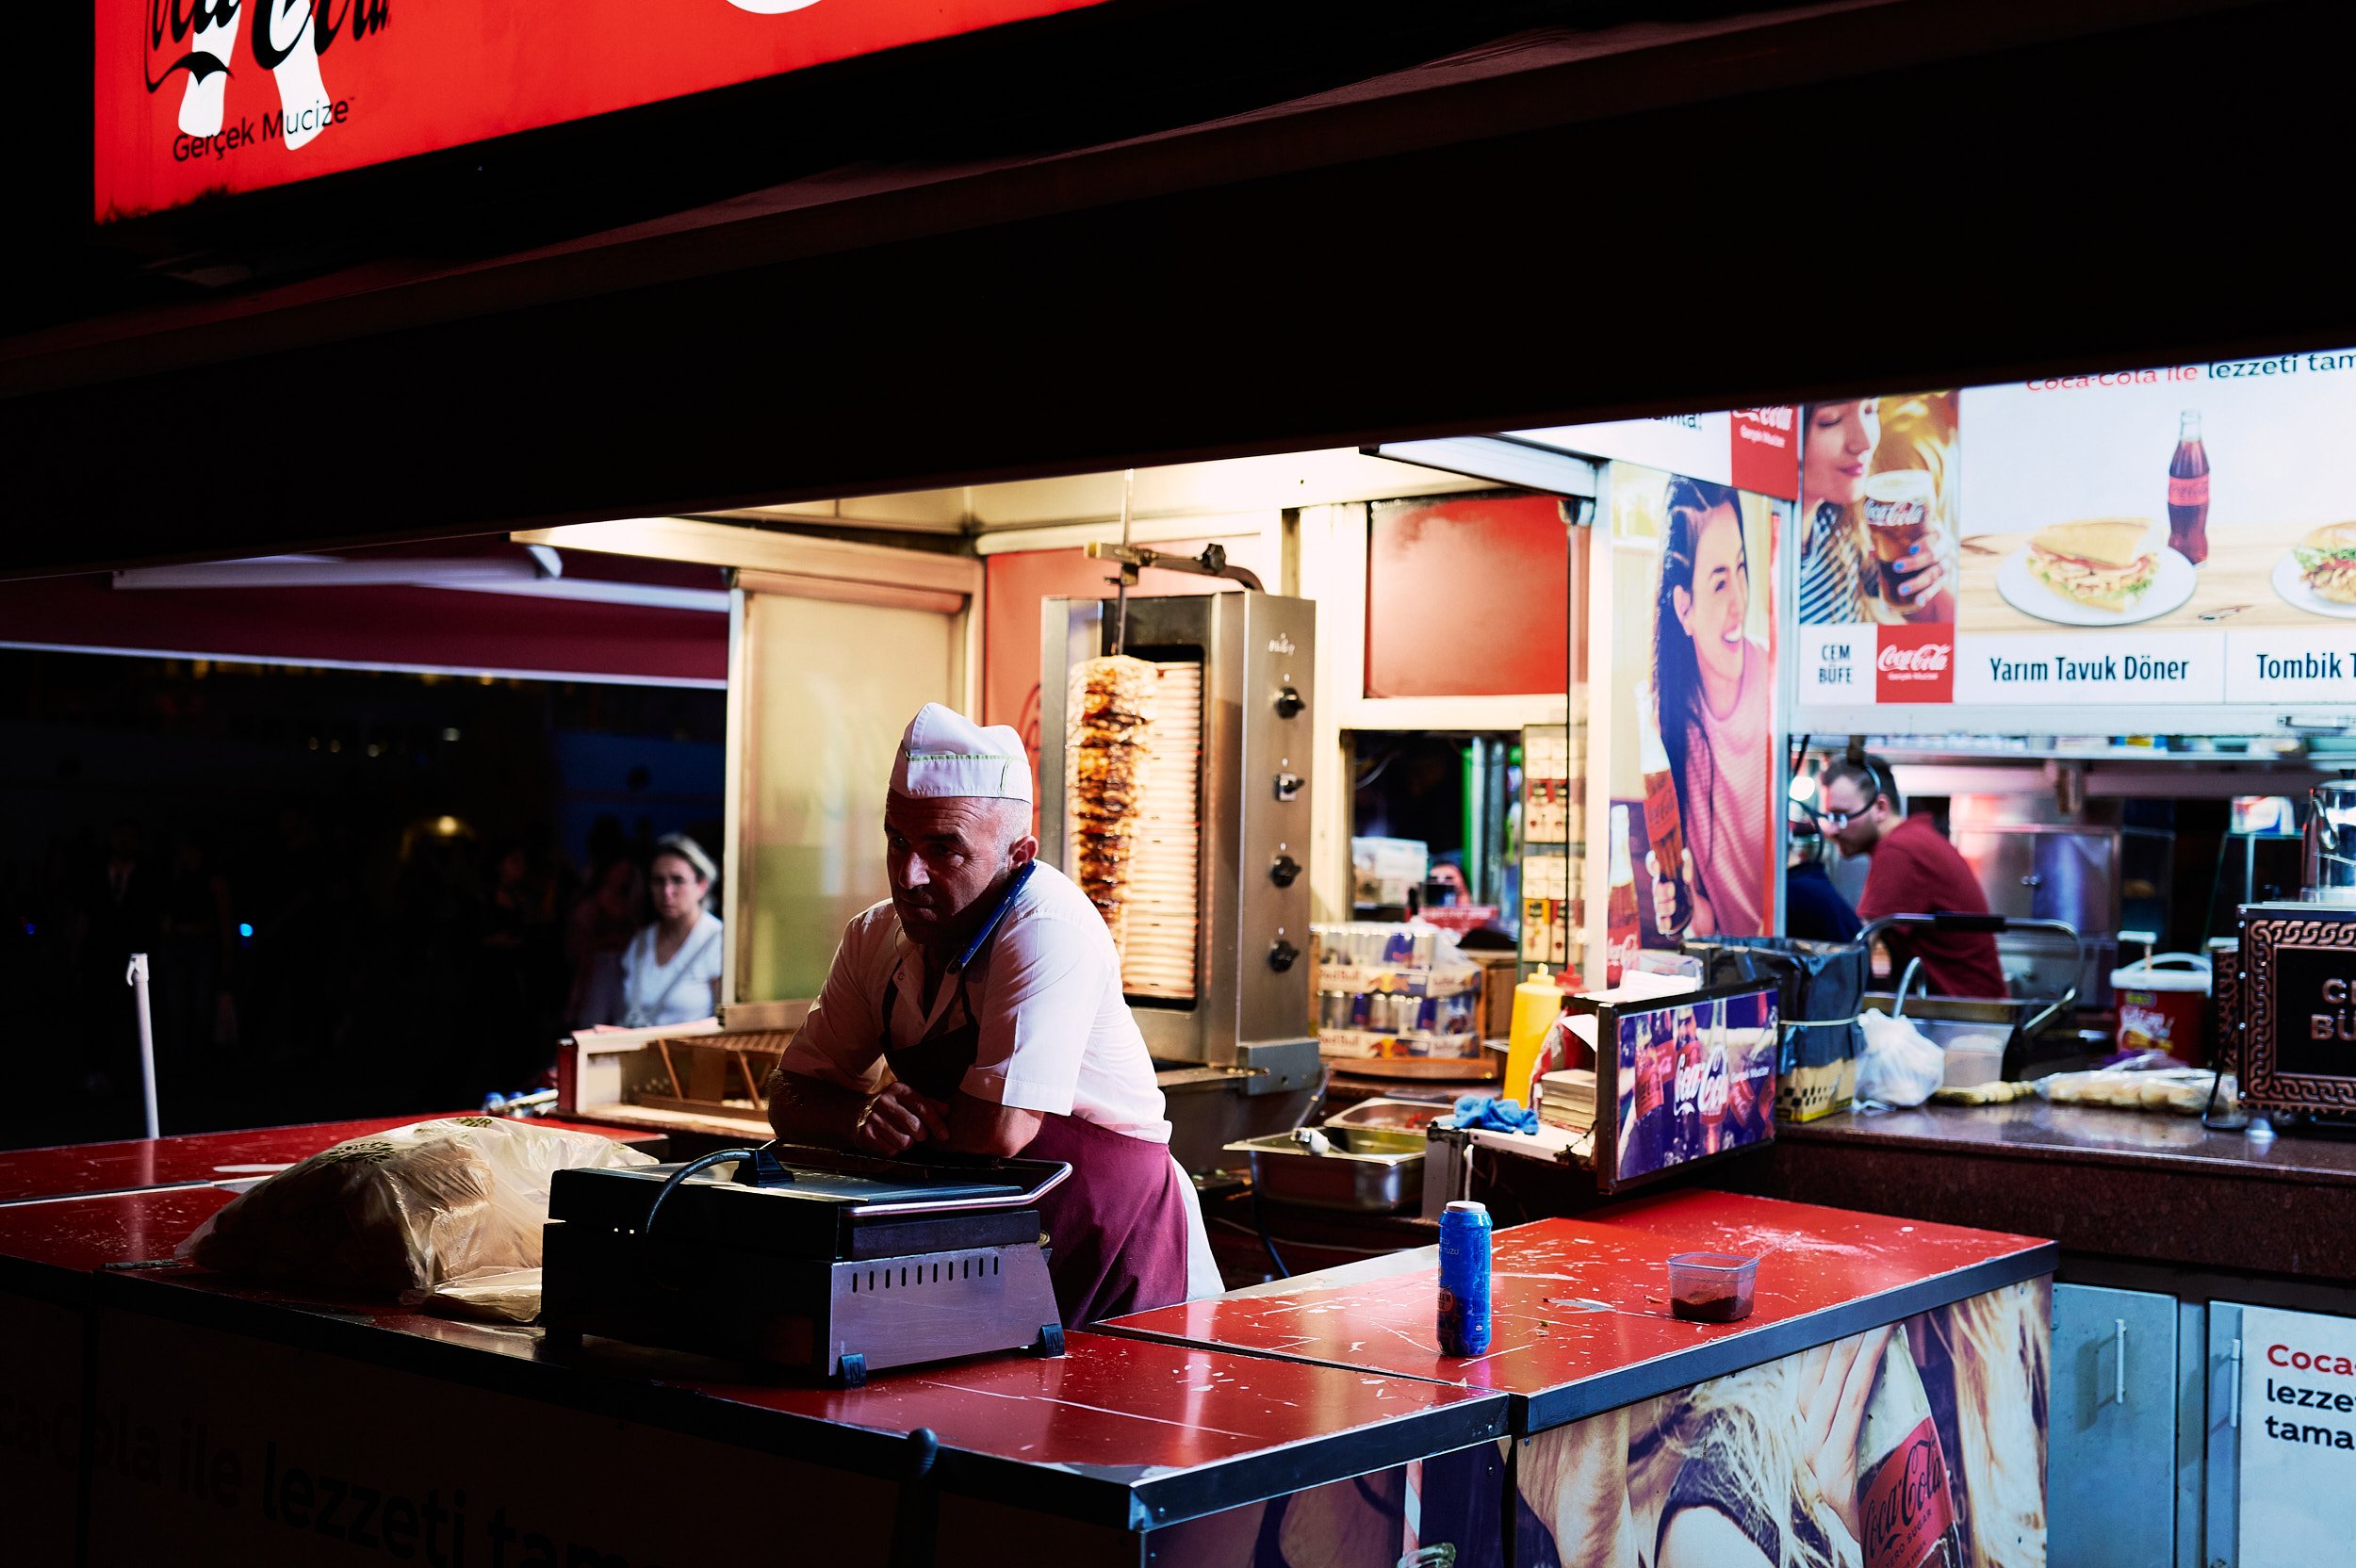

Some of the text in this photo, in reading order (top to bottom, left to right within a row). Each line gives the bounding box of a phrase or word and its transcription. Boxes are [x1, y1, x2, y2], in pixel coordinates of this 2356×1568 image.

[173, 99, 350, 162] Gerçek Mucize
[2208, 353, 2299, 379] lezzeti
[1822, 645, 1851, 661] CEM
[1877, 644, 1952, 672] Coca-Cola
[2256, 652, 2342, 679] Tombik
[1819, 664, 1853, 684] BÜFE
[1990, 655, 2189, 681] Yarım Tavuk Döner
[2322, 978, 2356, 1006] C
[2266, 1344, 2356, 1376] Coca
[2266, 1378, 2356, 1413] lezze
[2265, 1415, 2355, 1450] tama
